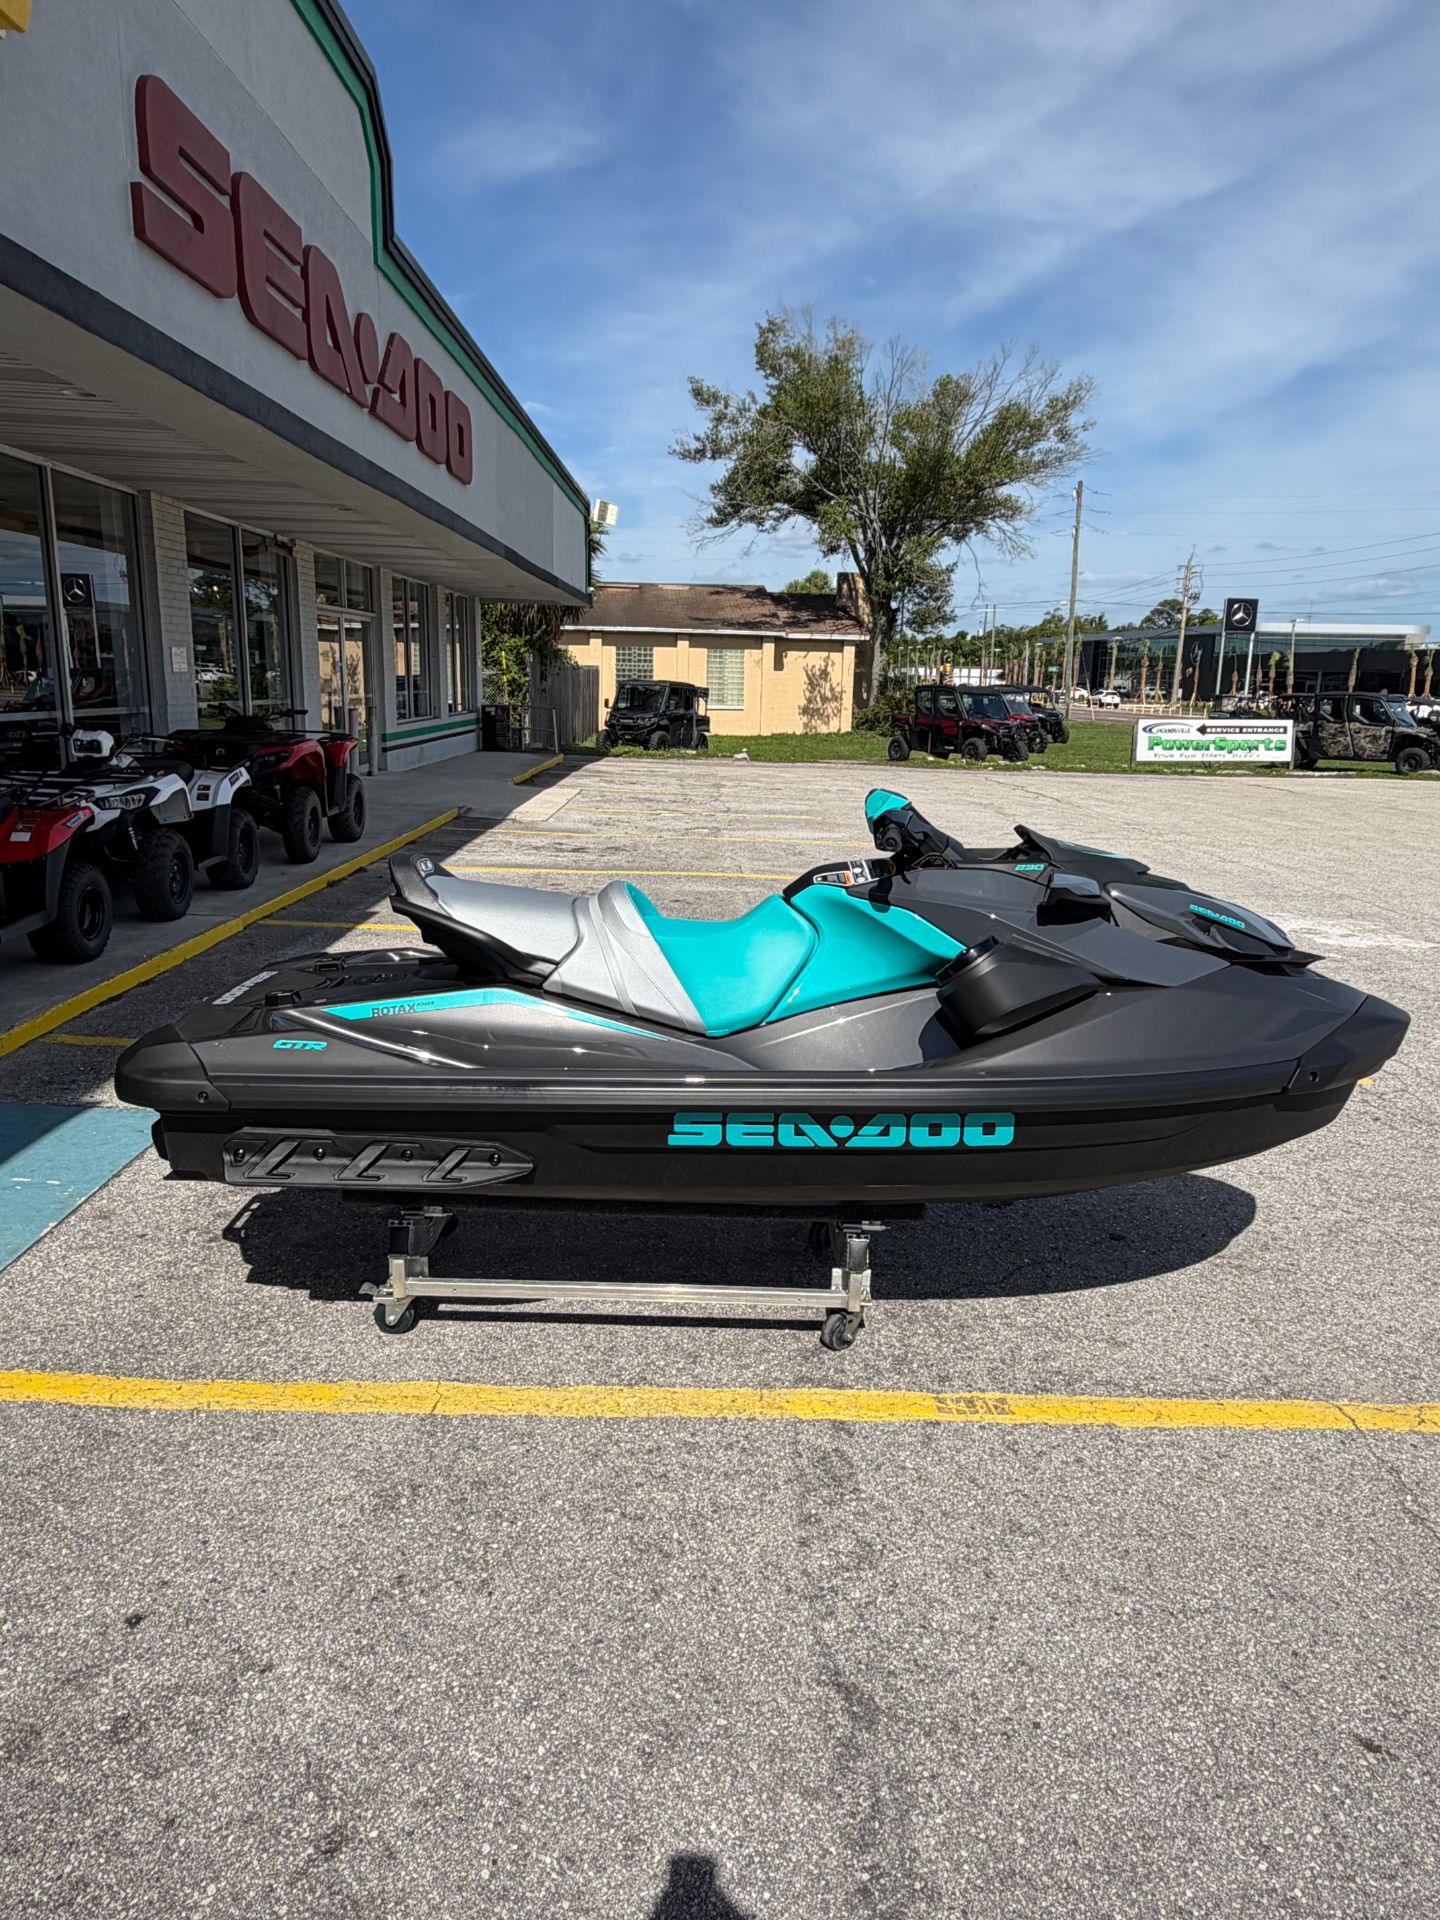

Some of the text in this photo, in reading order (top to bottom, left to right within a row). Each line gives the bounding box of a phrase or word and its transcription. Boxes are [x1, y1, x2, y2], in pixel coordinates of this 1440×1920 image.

[1148, 735, 1287, 754] PowerSports
[371, 1003, 416, 1018] ROTAX
[272, 1039, 328, 1050] GTR
